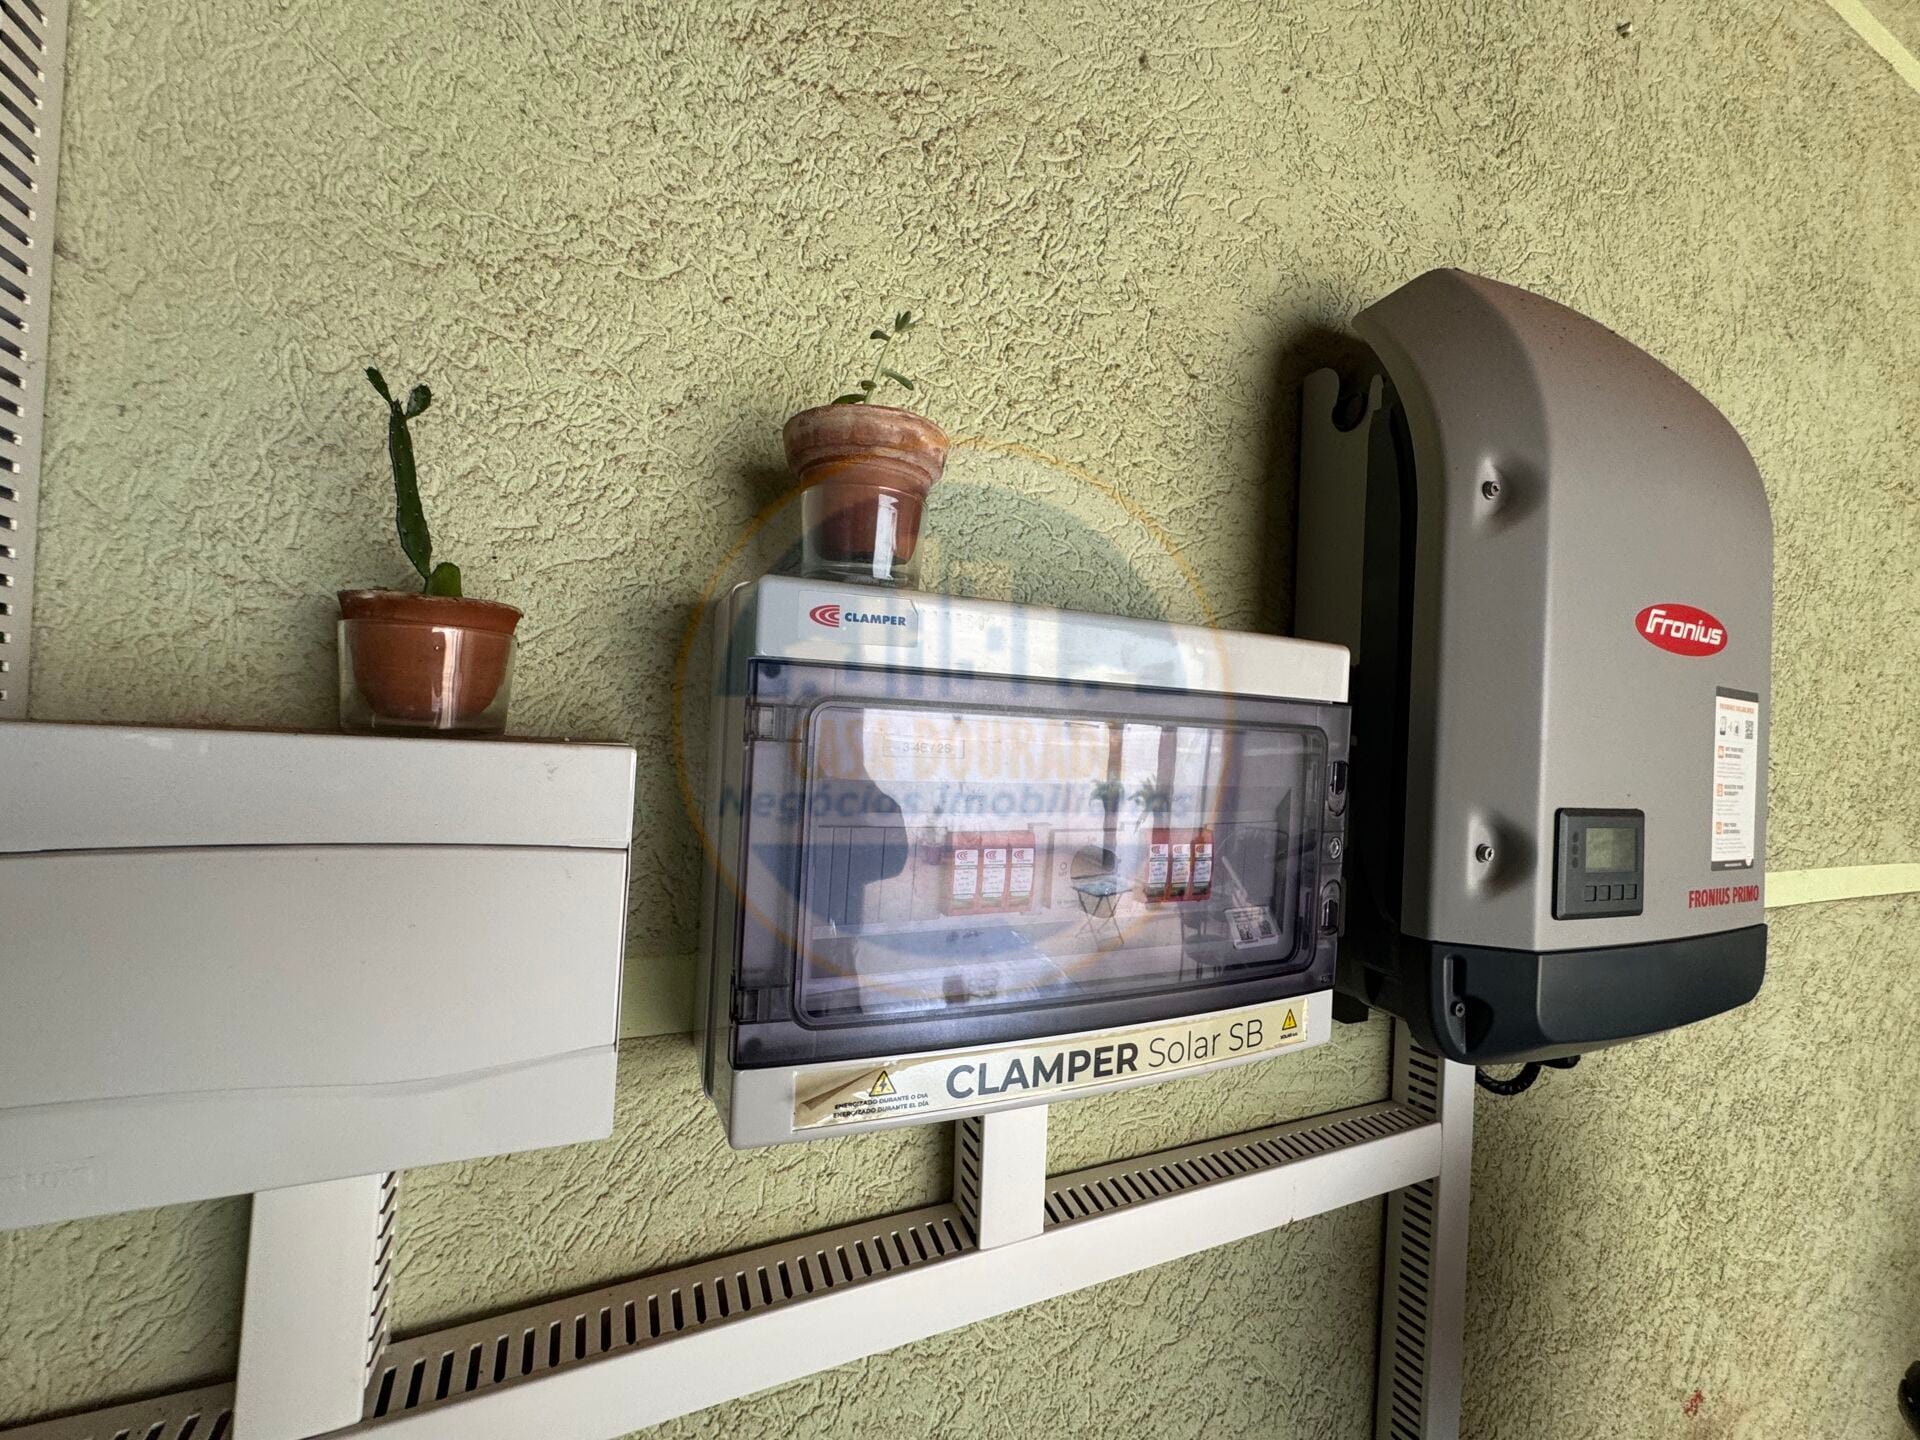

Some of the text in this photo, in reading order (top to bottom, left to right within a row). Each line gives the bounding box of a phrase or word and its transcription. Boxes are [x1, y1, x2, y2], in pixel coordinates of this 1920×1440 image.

[844, 612, 907, 627] CLAMPER
[1645, 608, 1723, 646] Fronius
[1688, 884, 1760, 909] FRONIUS PRIMO
[946, 1018, 1264, 1099] CLAMPER Solar SB
[877, 1103, 909, 1113] DURANTE
[879, 1094, 910, 1104] DURANTE
